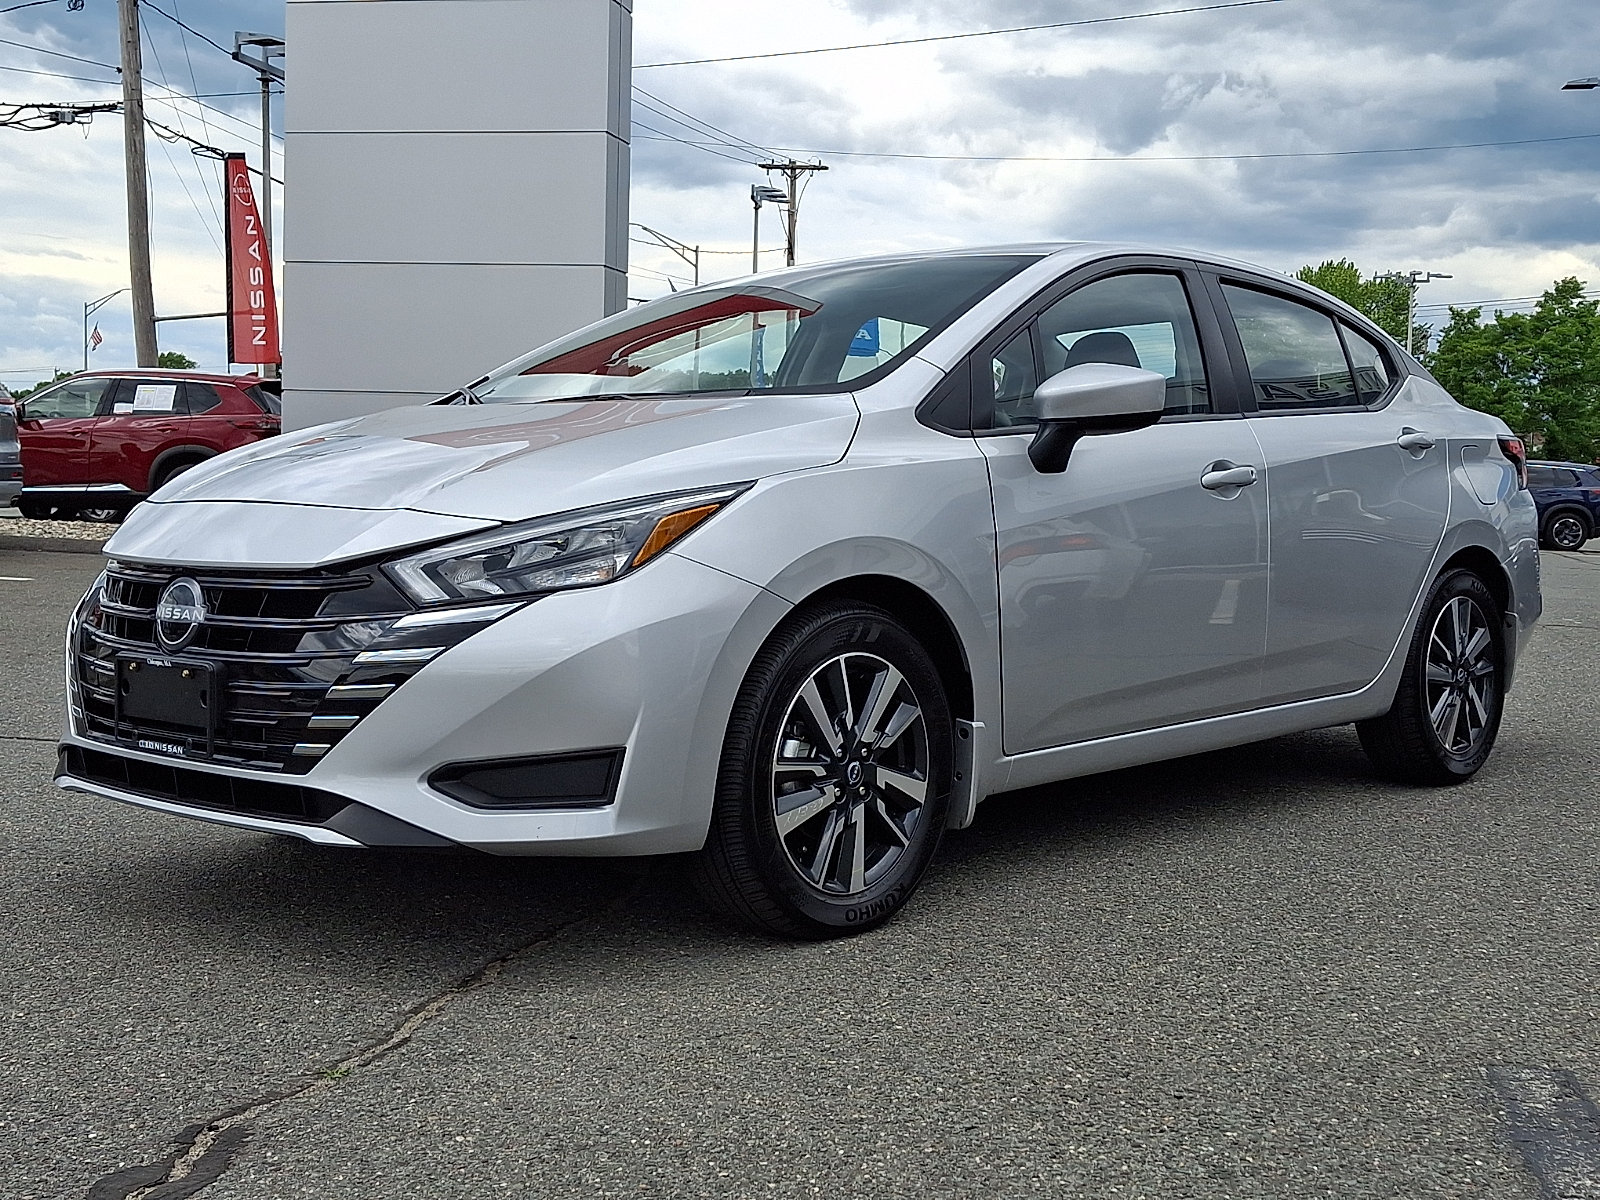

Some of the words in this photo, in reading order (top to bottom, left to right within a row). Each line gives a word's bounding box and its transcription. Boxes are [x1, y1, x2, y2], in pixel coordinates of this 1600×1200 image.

[245, 216, 267, 345] NISSAN
[156, 605, 205, 621] NISSAN
[154, 742, 183, 755] NISSAN
[845, 883, 906, 922] KUMHO
